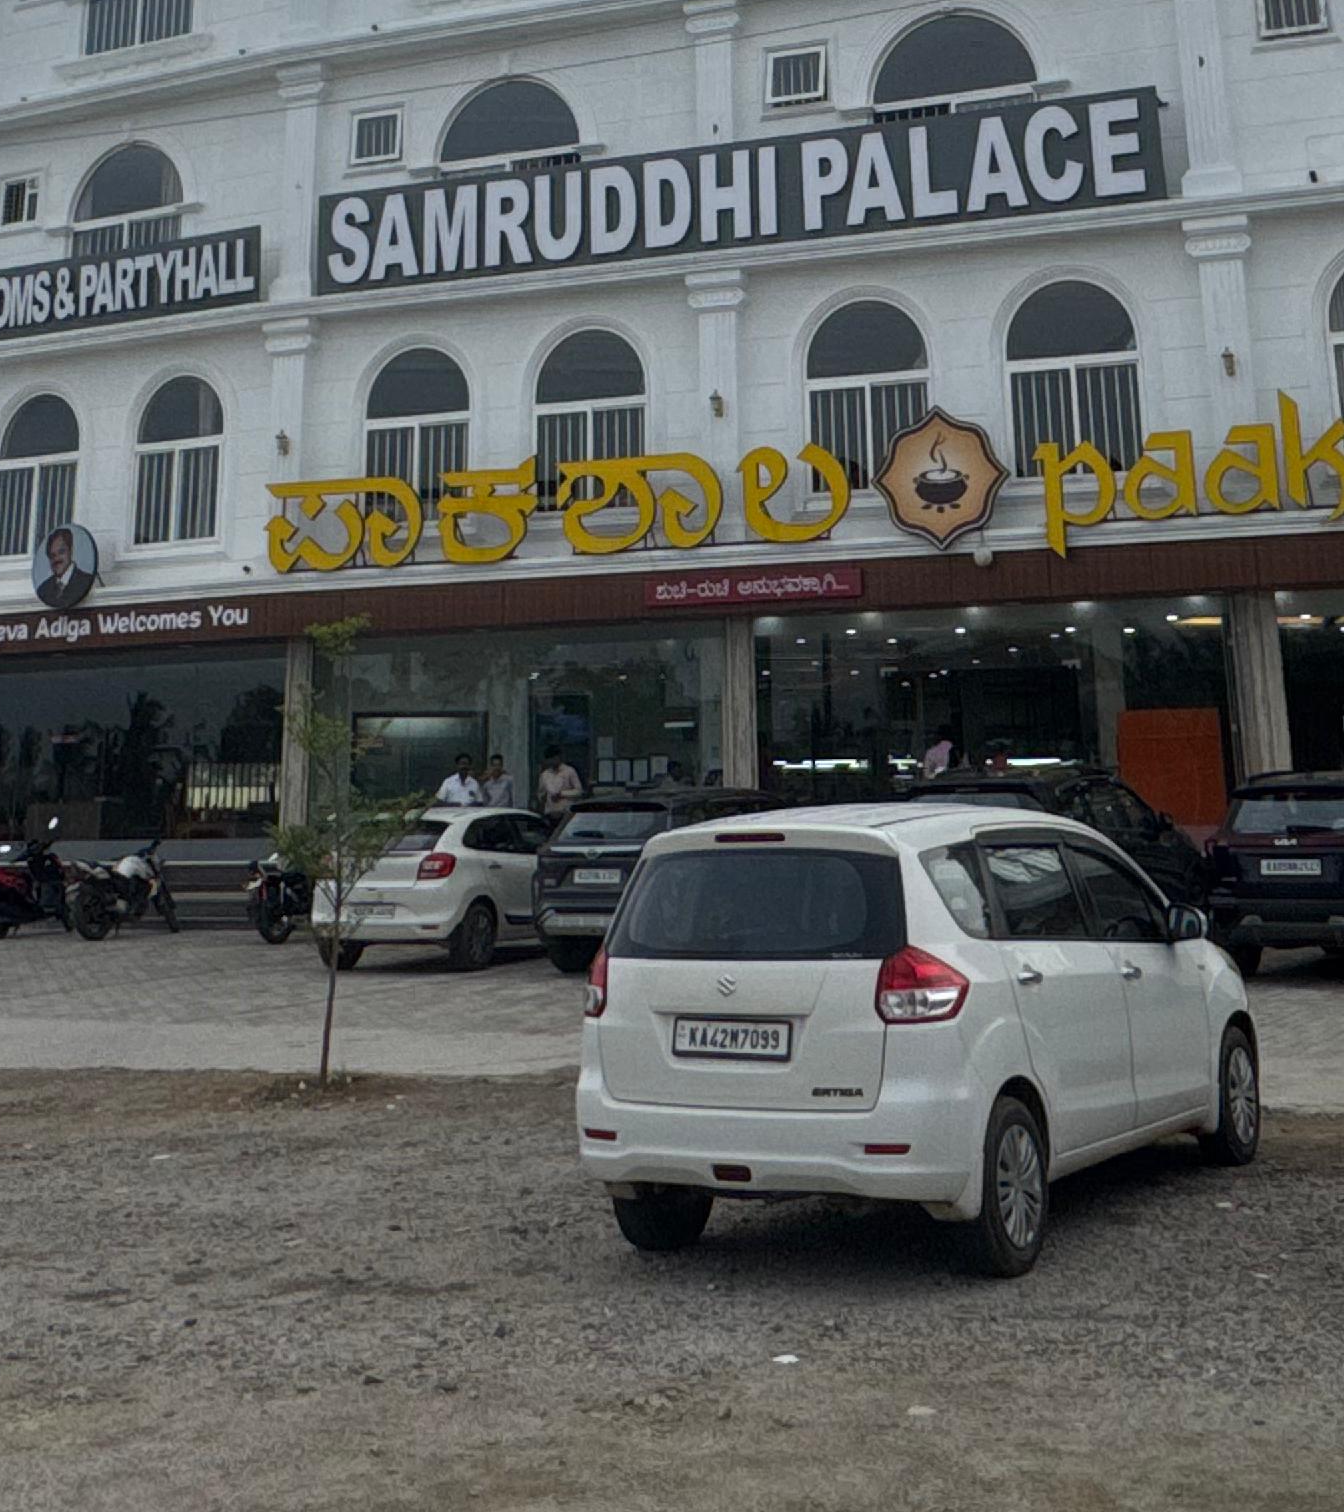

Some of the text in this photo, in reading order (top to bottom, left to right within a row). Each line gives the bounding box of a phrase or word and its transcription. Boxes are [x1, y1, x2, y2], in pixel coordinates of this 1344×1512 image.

[327, 97, 1149, 285] SAMRUDDHI PALACE
[54, 266, 76, 320] &
[34, 616, 93, 643] Adiga
[97, 606, 203, 635] Welcomes
[208, 604, 250, 627] You
[688, 1025, 780, 1050] KA42M7099
